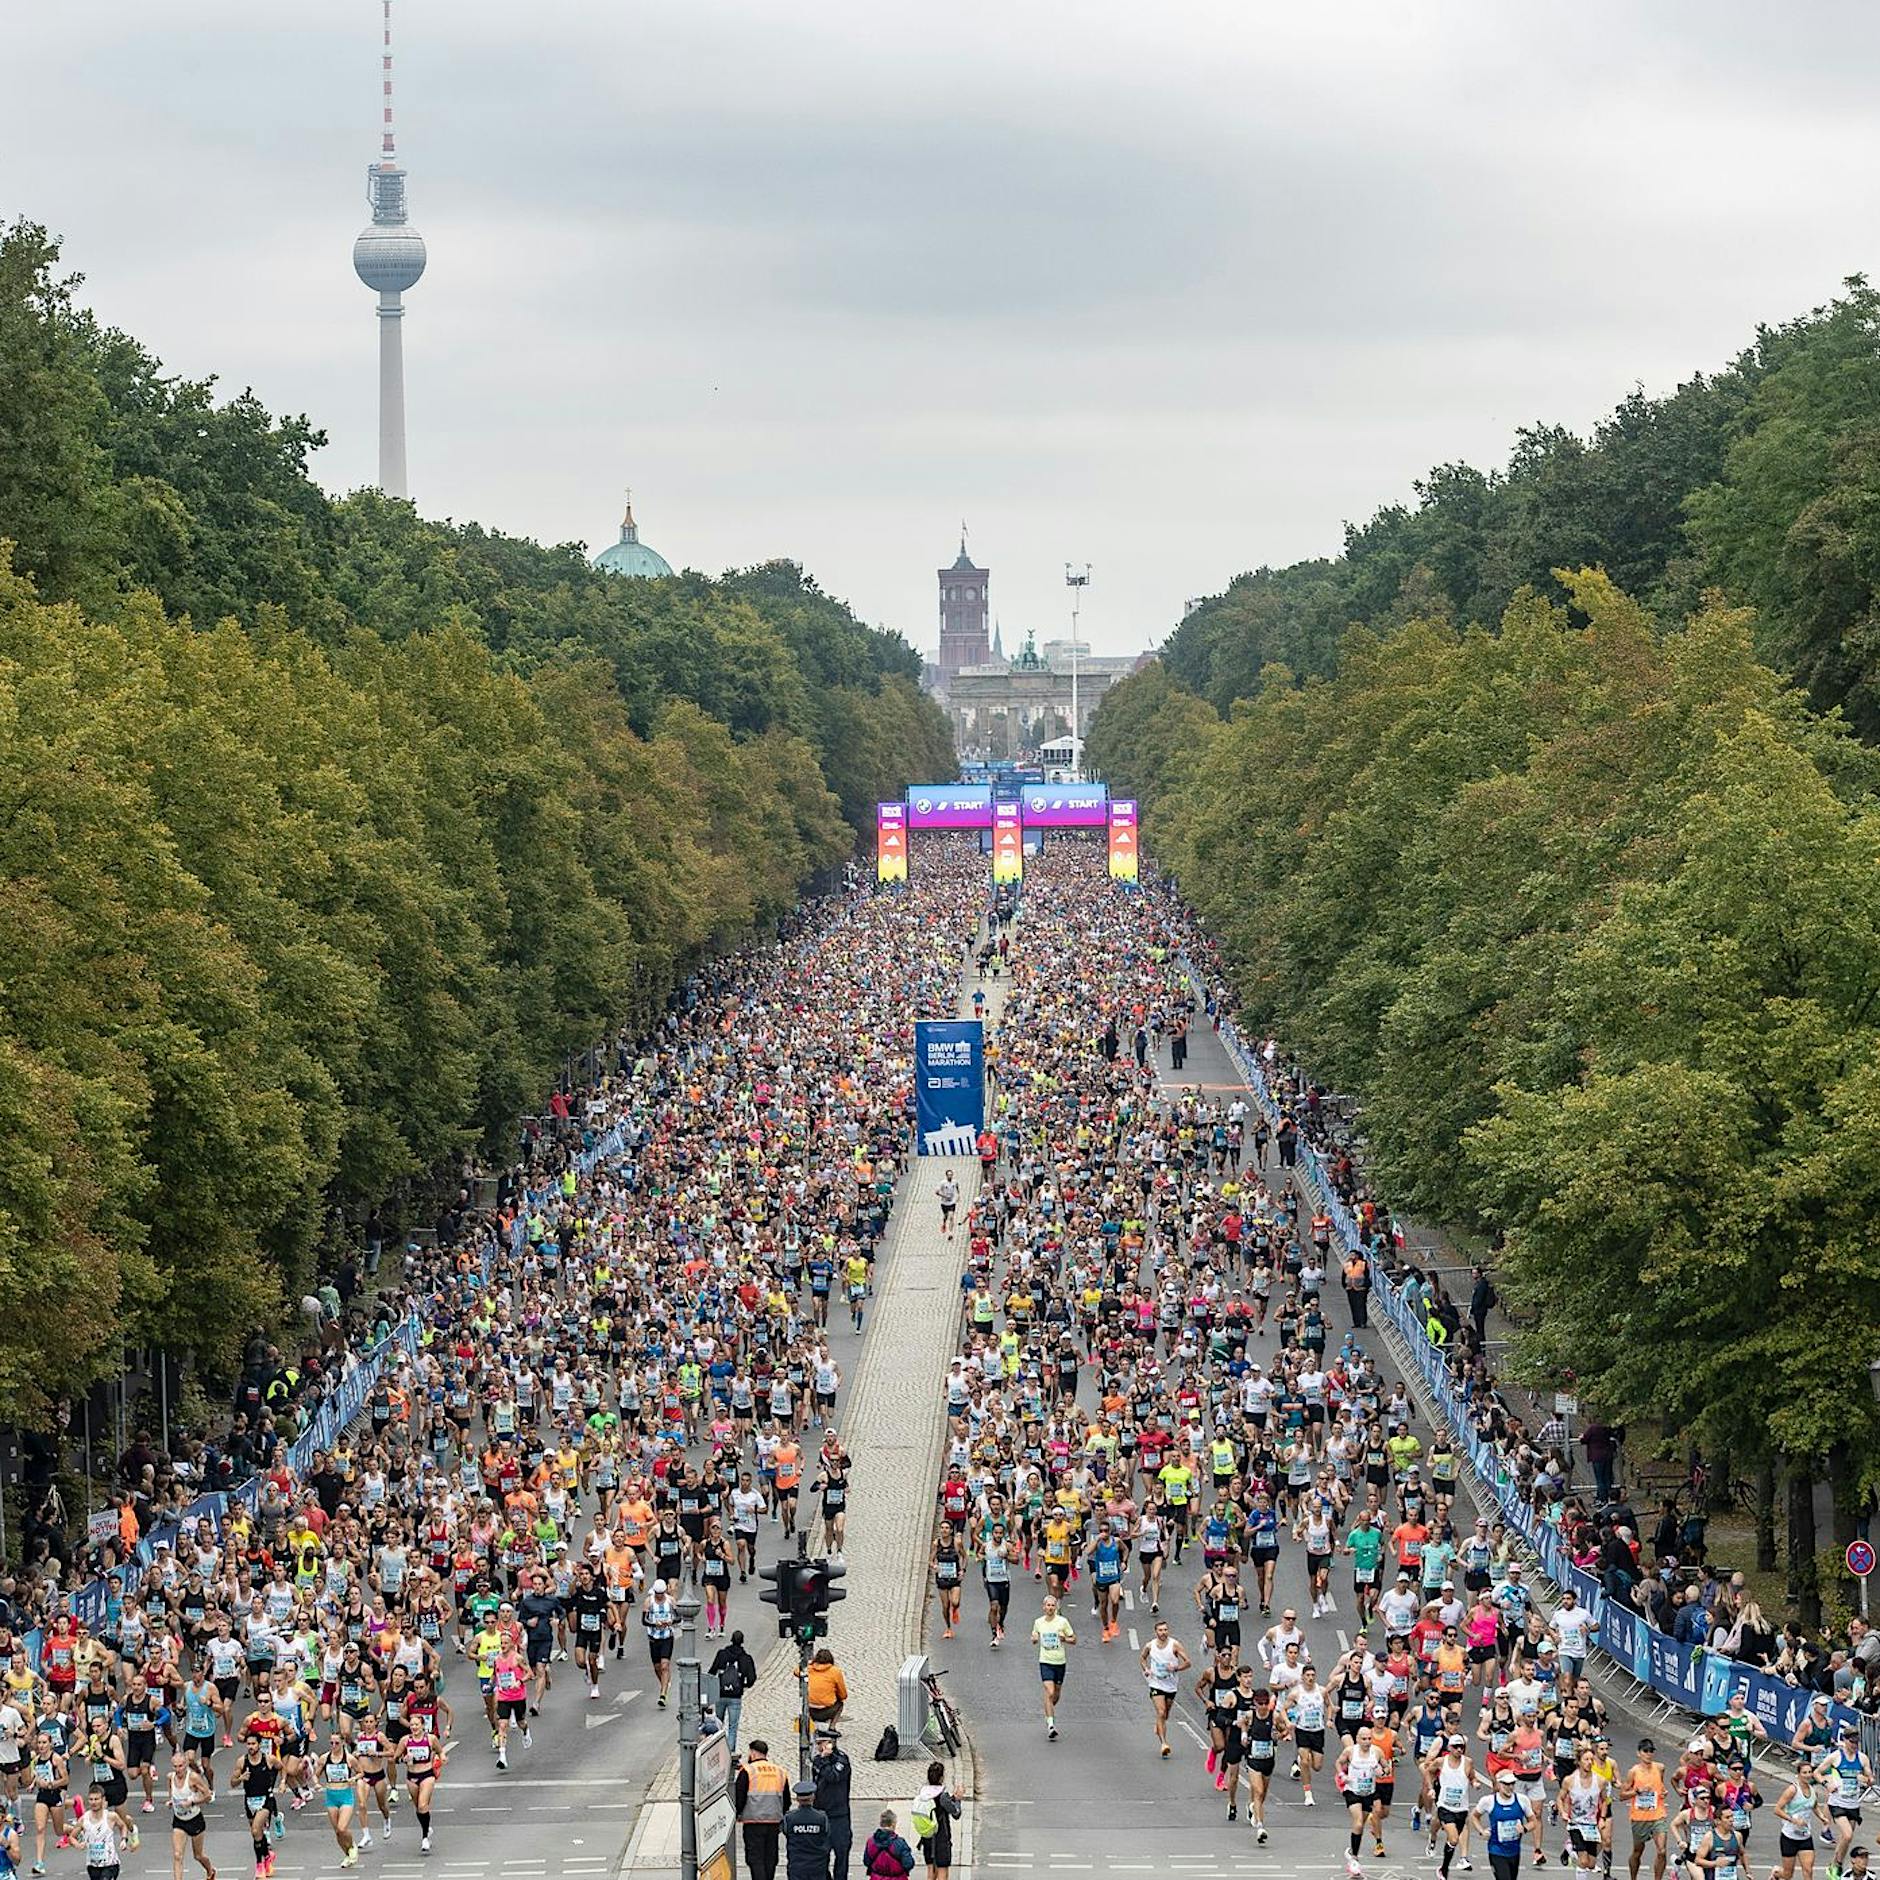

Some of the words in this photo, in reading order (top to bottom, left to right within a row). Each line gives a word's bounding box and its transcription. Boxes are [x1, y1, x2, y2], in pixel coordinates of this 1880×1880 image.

[954, 801, 983, 810] START
[1069, 799, 1098, 809] START
[928, 1043, 954, 1052] BMW
[793, 1825, 820, 1833] POLIZEI
